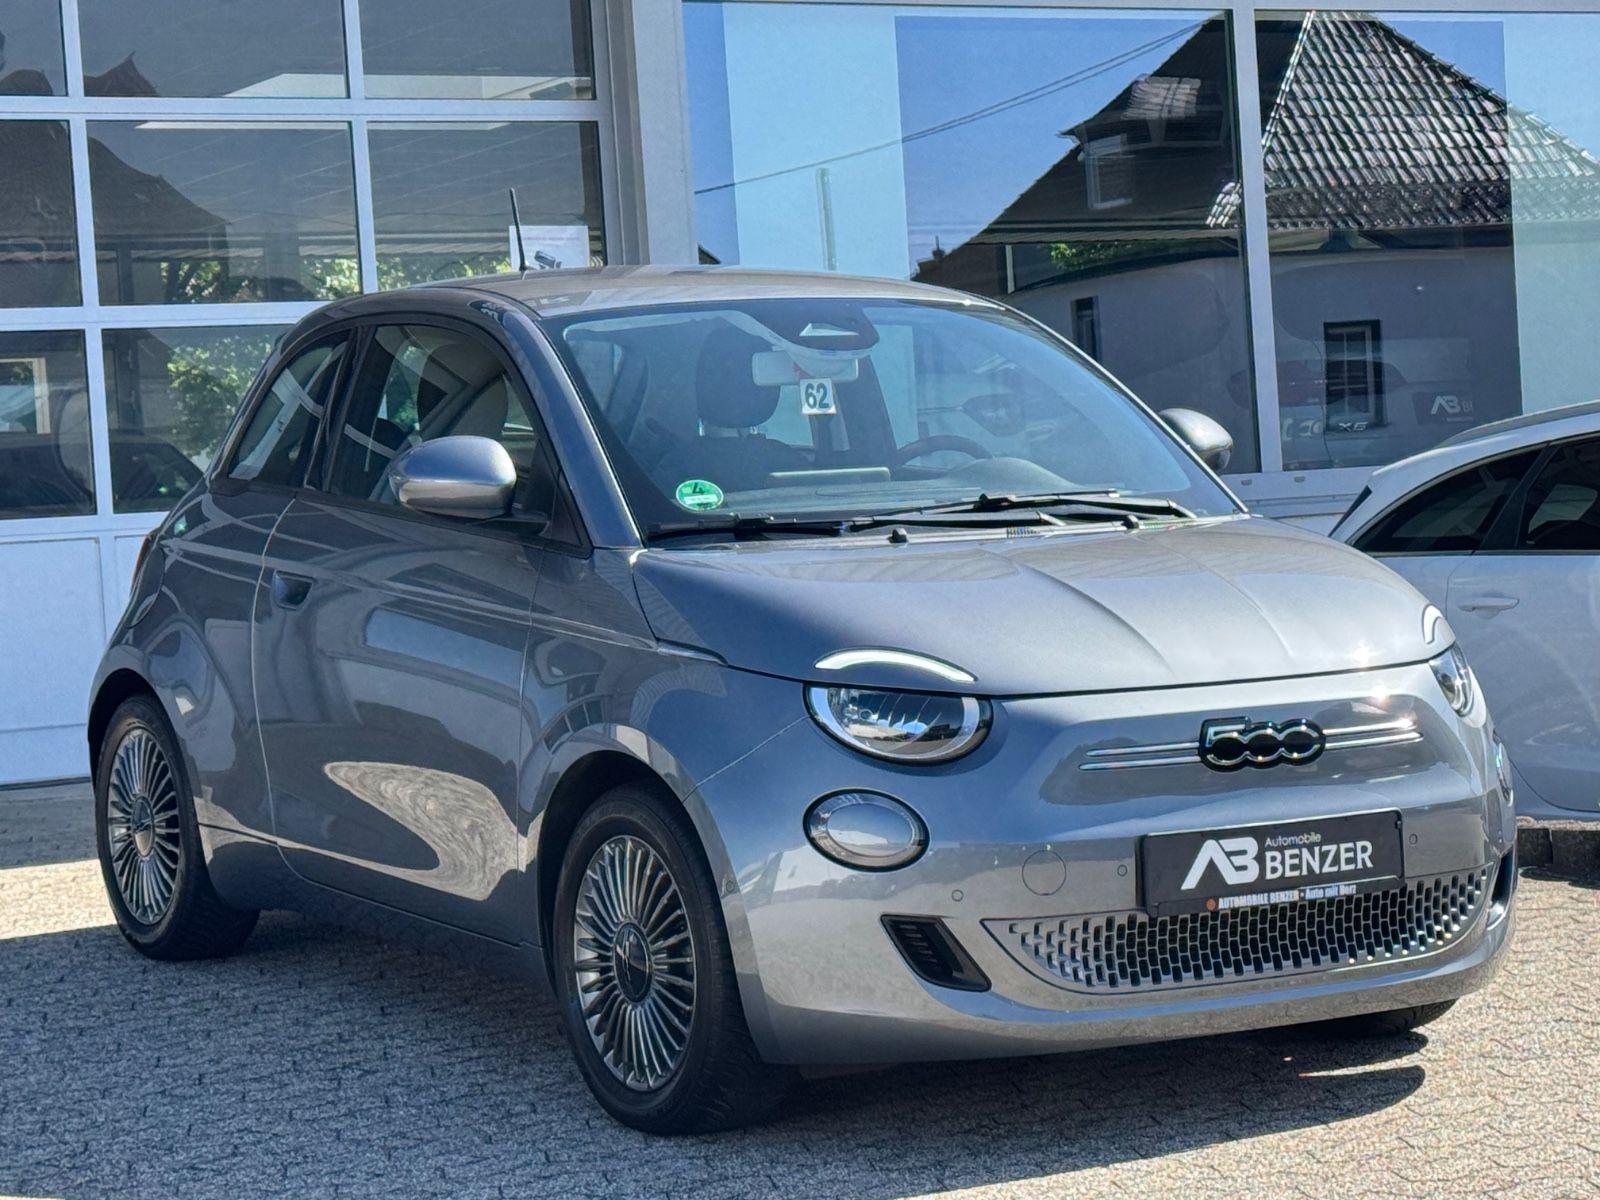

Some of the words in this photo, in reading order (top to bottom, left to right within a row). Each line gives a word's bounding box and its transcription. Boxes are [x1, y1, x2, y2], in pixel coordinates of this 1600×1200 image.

[805, 382, 829, 409] 62
[1338, 421, 1369, 432] X6
[692, 482, 706, 495] 4
[1203, 718, 1324, 770] 500
[1264, 831, 1322, 848] Automobile
[1180, 836, 1260, 891] AB
[1264, 840, 1374, 880] BENZER
[1218, 892, 1269, 910] AUTOMOBILE
[1269, 889, 1300, 904] BENZER
